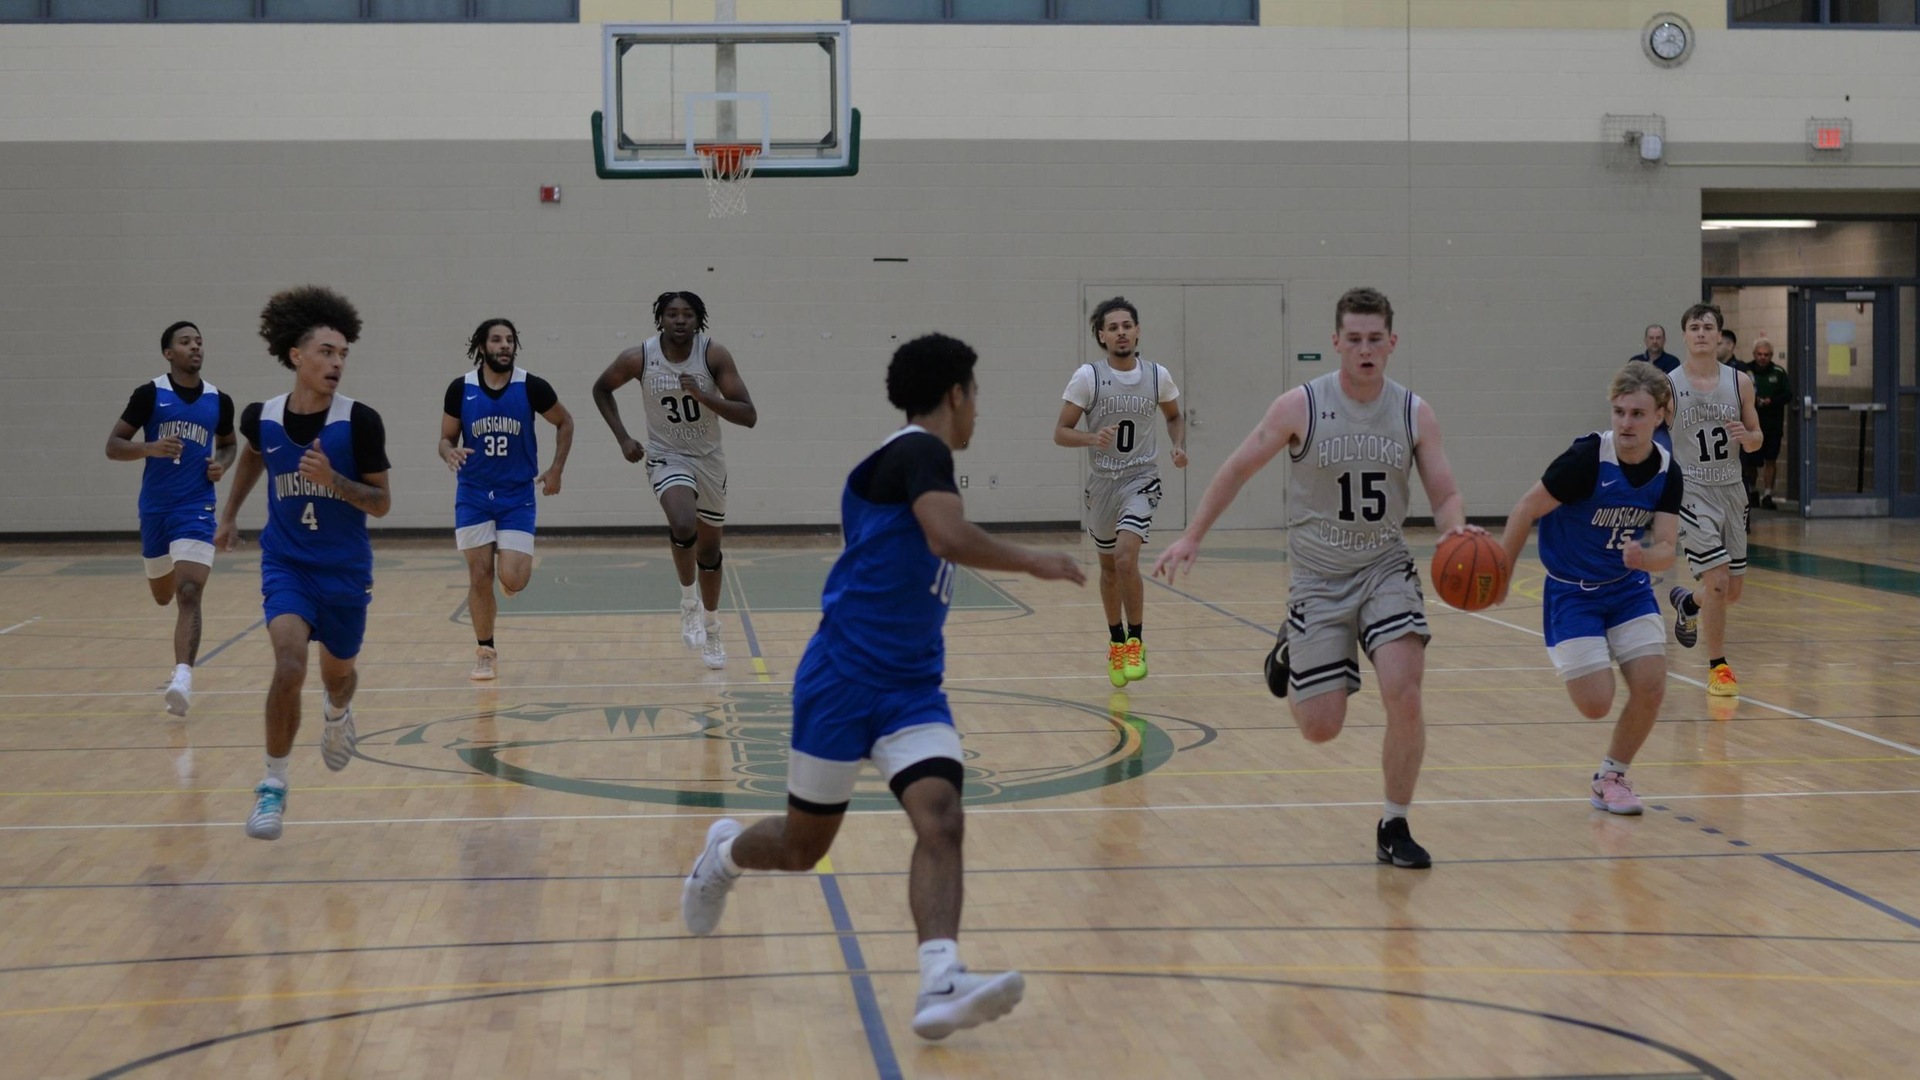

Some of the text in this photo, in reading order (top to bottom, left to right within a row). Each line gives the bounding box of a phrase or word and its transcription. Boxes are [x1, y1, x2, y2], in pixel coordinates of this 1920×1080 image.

[660, 395, 701, 424] 30
[1099, 395, 1155, 418] HOLYOKE
[1681, 403, 1736, 429] HOLYOKE
[472, 415, 521, 438] QUINSIGAMOND
[1115, 419, 1136, 455] 0
[483, 435, 508, 457] 32
[1317, 434, 1404, 470] HOLYOKE
[1695, 426, 1730, 463] 12
[1336, 471, 1388, 523] 15
[300, 501, 319, 531] 4
[1605, 527, 1636, 550] 15
